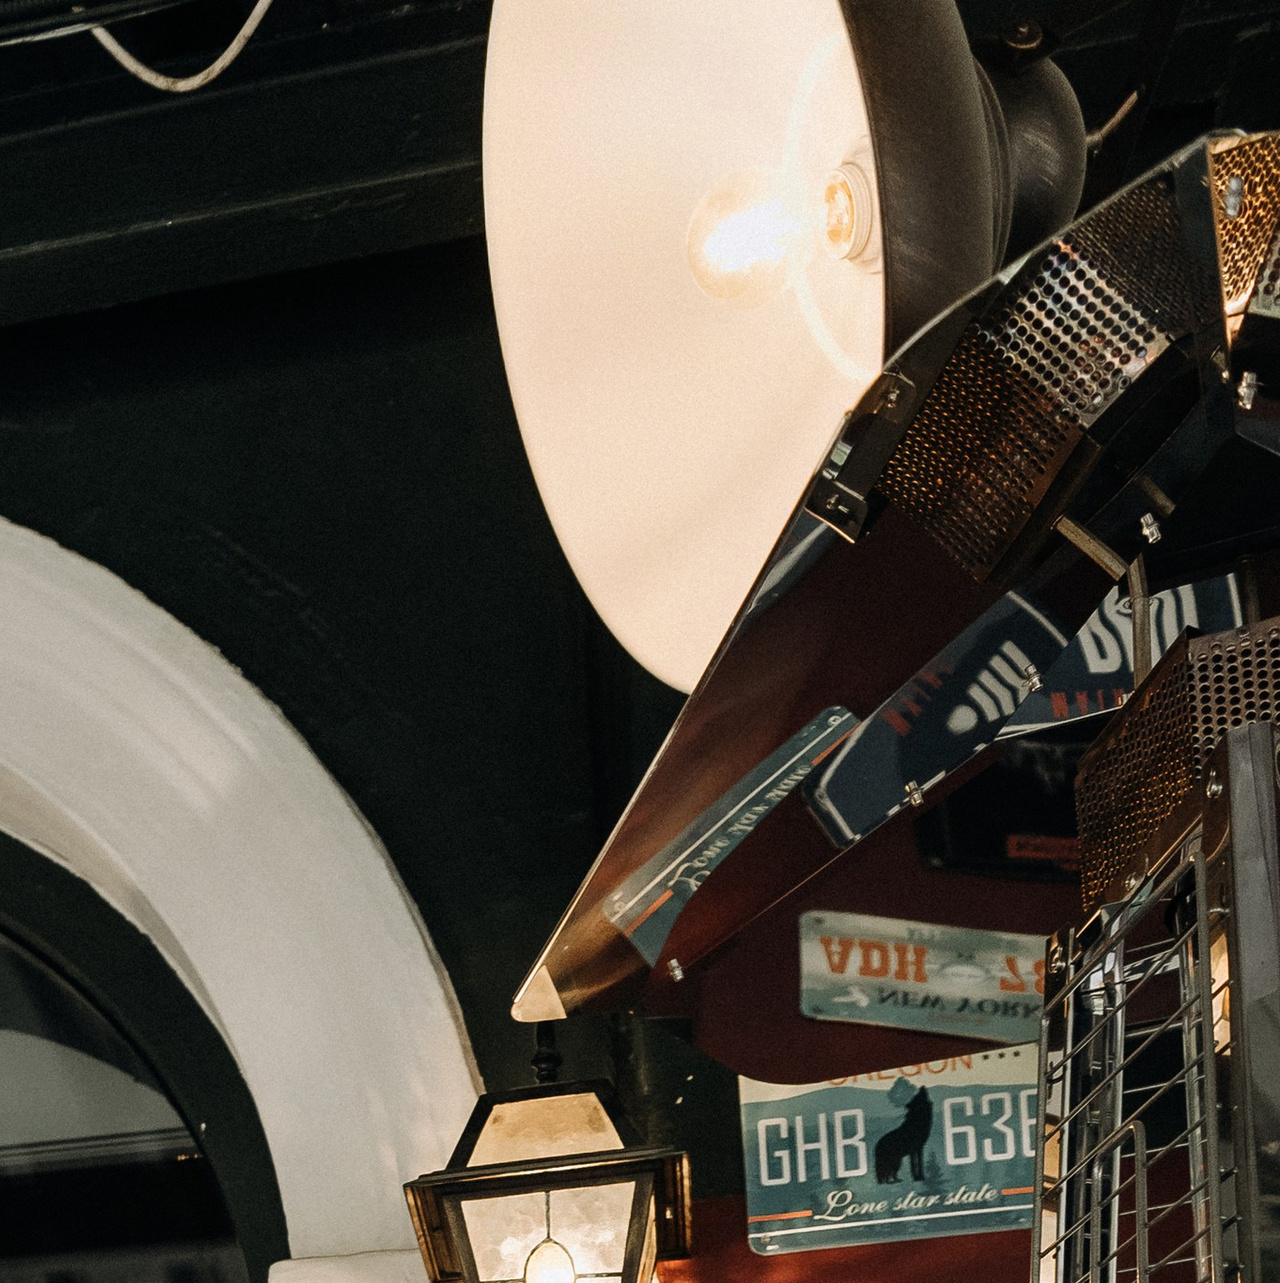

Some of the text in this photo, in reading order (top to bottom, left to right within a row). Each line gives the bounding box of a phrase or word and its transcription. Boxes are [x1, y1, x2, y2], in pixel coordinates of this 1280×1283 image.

[757, 1108, 868, 1187] GHB
[814, 1182, 999, 1222] Lone star state
